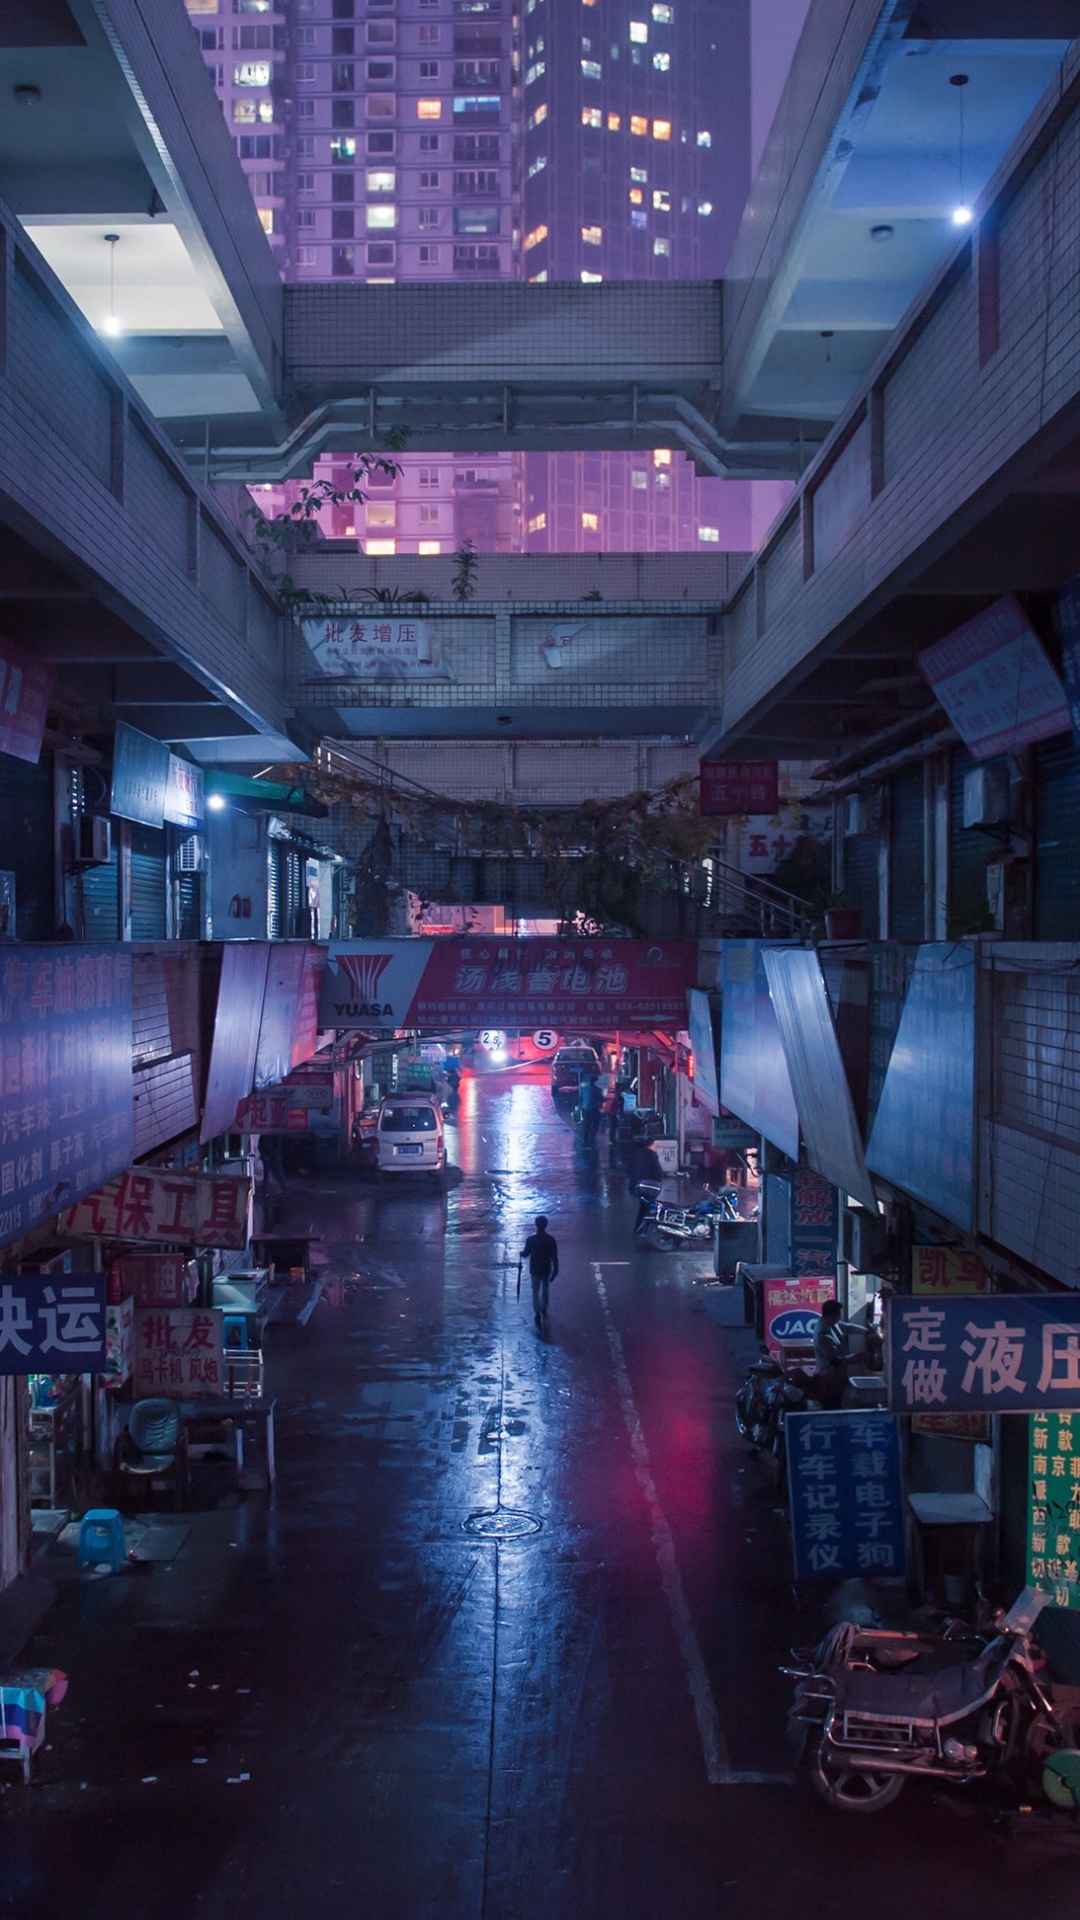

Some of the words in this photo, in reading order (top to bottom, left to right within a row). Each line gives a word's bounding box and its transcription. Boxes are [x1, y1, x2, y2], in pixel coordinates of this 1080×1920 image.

[324, 622, 417, 644] 批发增压
[454, 964, 629, 994] 汤浅蓄电池
[334, 1003, 394, 1016] YUASA
[538, 1031, 552, 1046] 5
[142, 1315, 215, 1350] 批发
[901, 1306, 949, 1405] 定做
[798, 1423, 844, 1571] 行车记录仪
[850, 1421, 896, 1568] 车载电子狗
